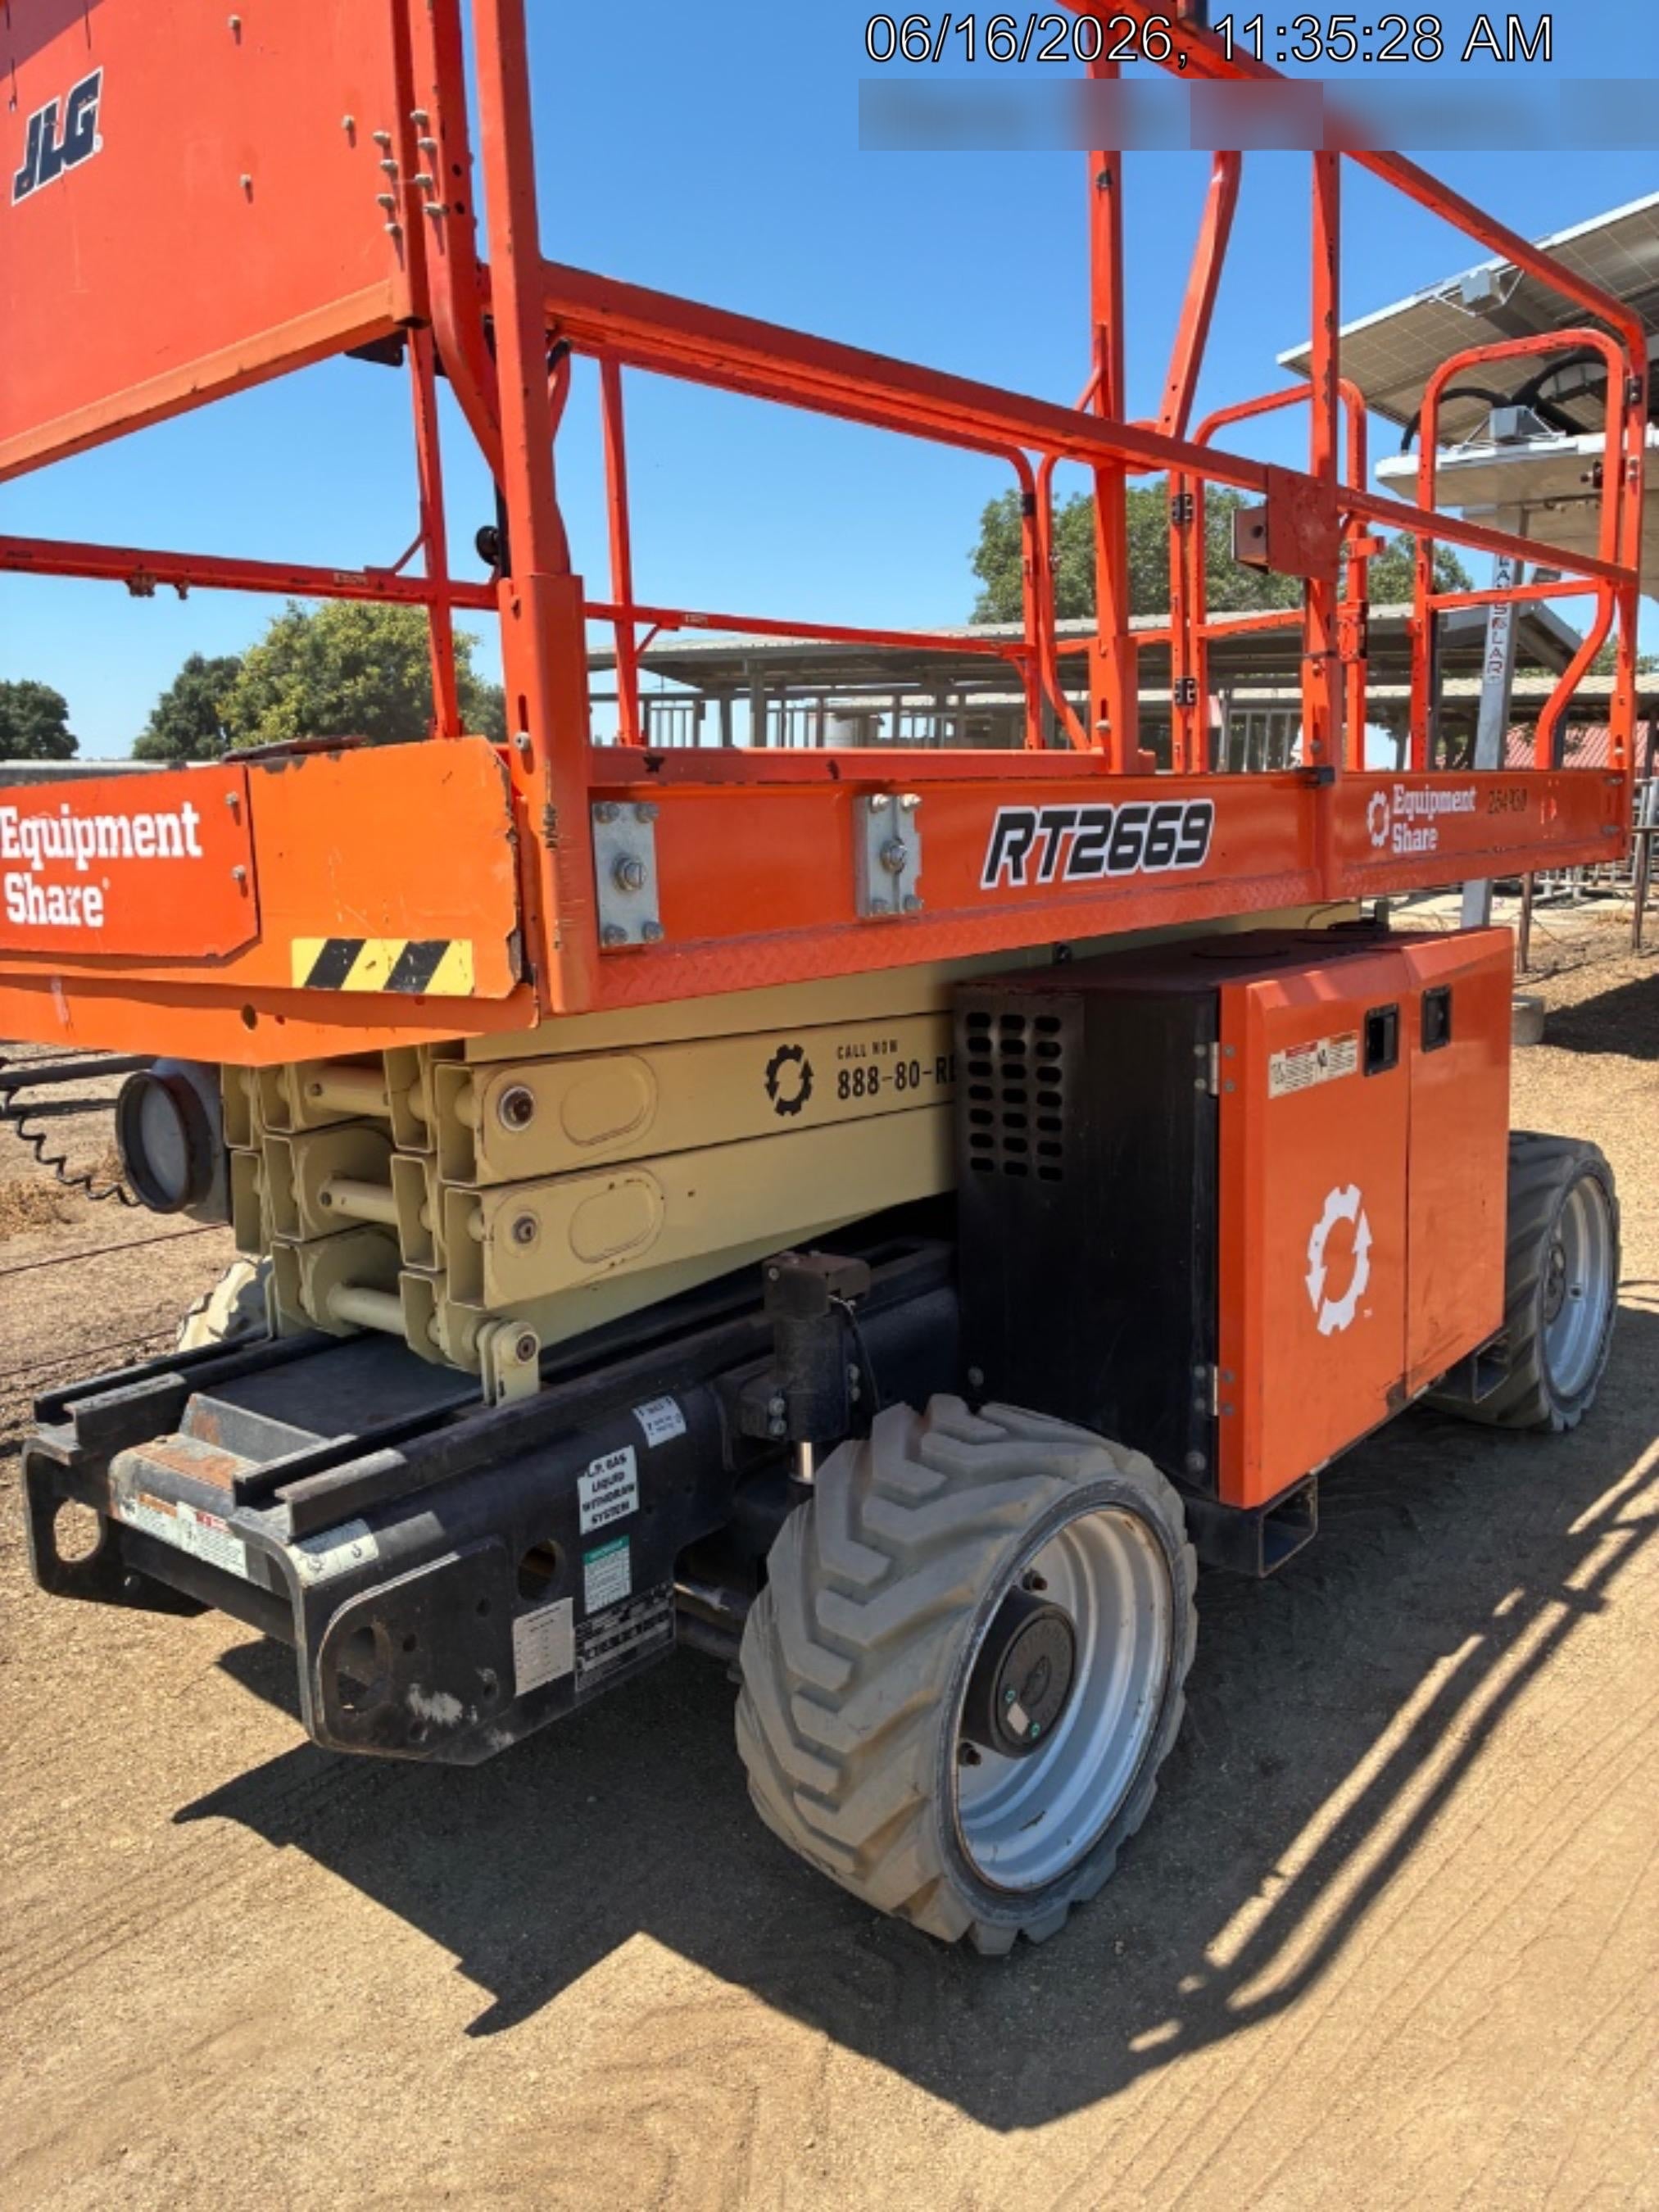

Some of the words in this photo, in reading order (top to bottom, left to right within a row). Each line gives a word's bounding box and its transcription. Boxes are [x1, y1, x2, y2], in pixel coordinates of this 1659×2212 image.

[11, 66, 104, 206] JLG
[1393, 783, 1477, 821] Equipment
[0, 801, 203, 872] Equipment
[980, 798, 1215, 889] RT2669
[1392, 823, 1439, 853] Share
[4, 872, 105, 928] Share
[837, 1043, 866, 1060] CALL
[872, 1040, 898, 1055] NOW
